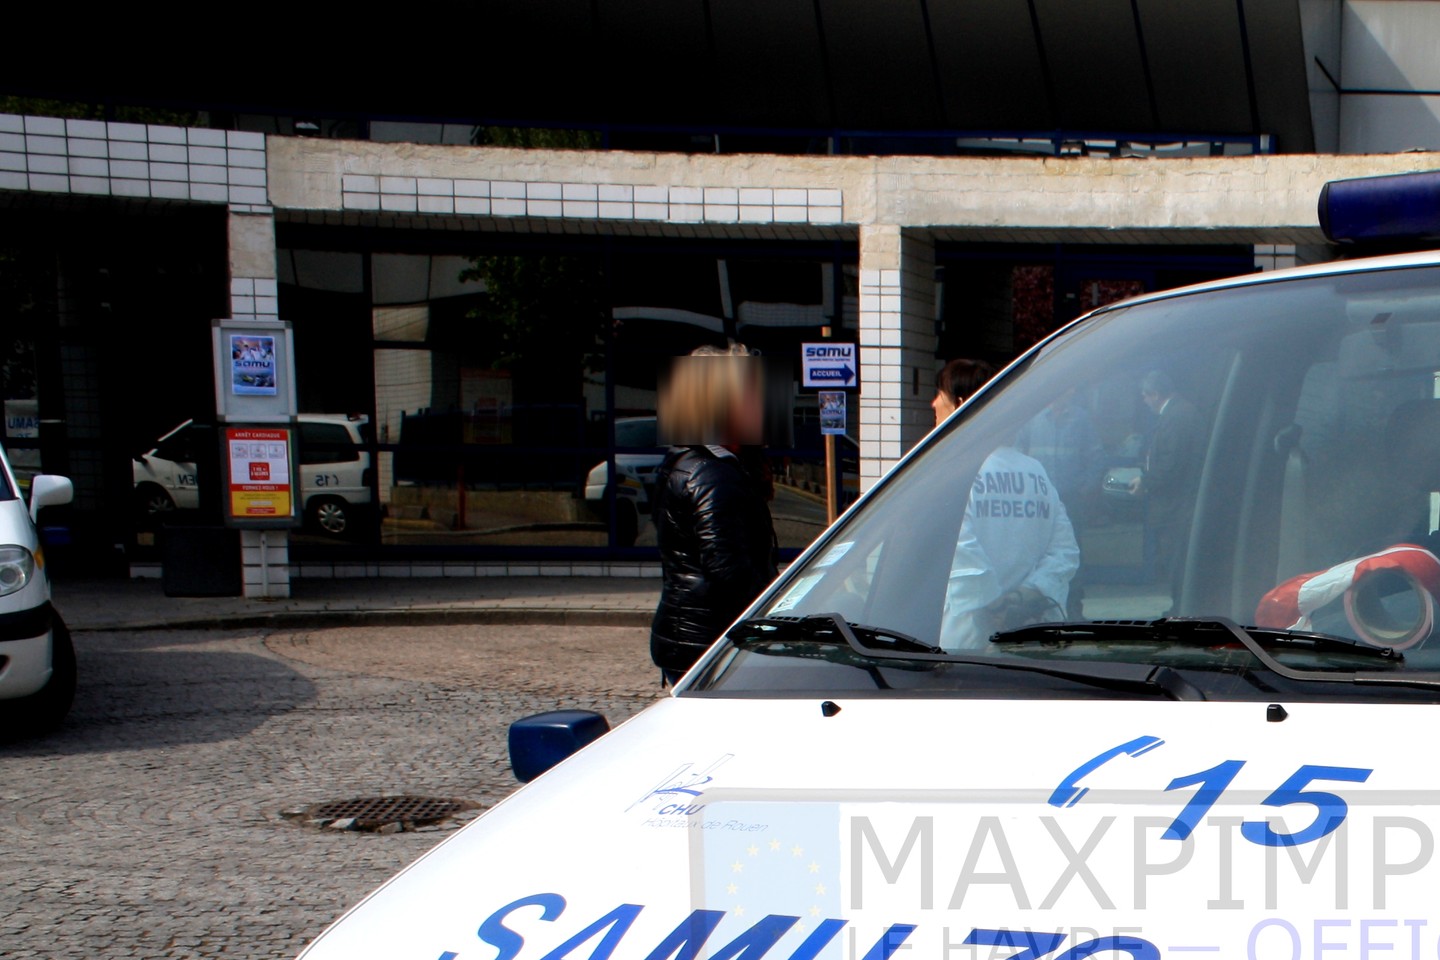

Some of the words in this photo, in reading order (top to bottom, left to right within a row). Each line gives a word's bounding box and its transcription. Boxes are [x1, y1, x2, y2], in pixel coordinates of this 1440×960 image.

[806, 347, 851, 357] samu
[974, 472, 1025, 494] SAMU
[1028, 473, 1048, 496] 76
[975, 501, 1050, 519] MEDECIN
[658, 804, 706, 815] CHU
[1159, 758, 1373, 848] 15
[701, 819, 721, 831] de
[722, 820, 769, 832] Rouen
